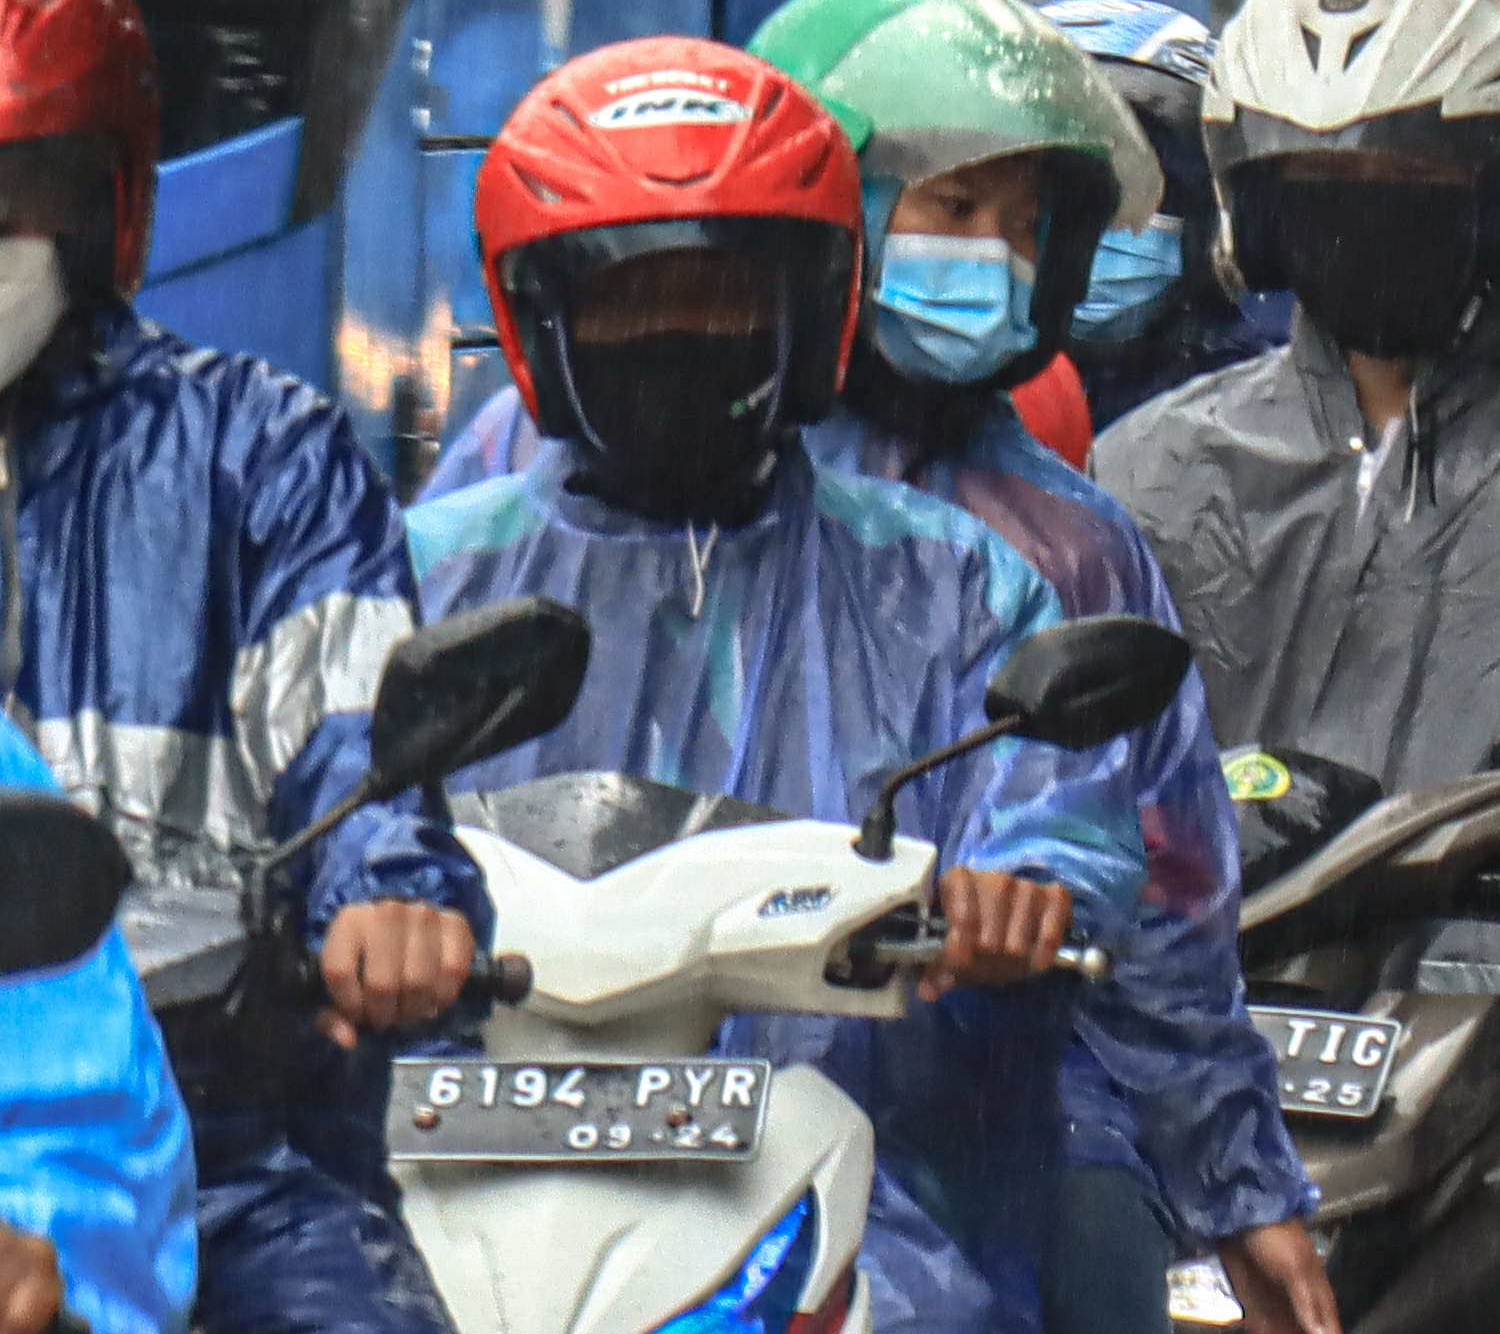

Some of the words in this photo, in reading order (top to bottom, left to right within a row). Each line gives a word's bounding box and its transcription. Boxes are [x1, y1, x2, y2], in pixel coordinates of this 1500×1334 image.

[1287, 1018, 1388, 1067] TIG
[428, 1067, 587, 1108] 6194
[634, 1067, 756, 1108] PYR
